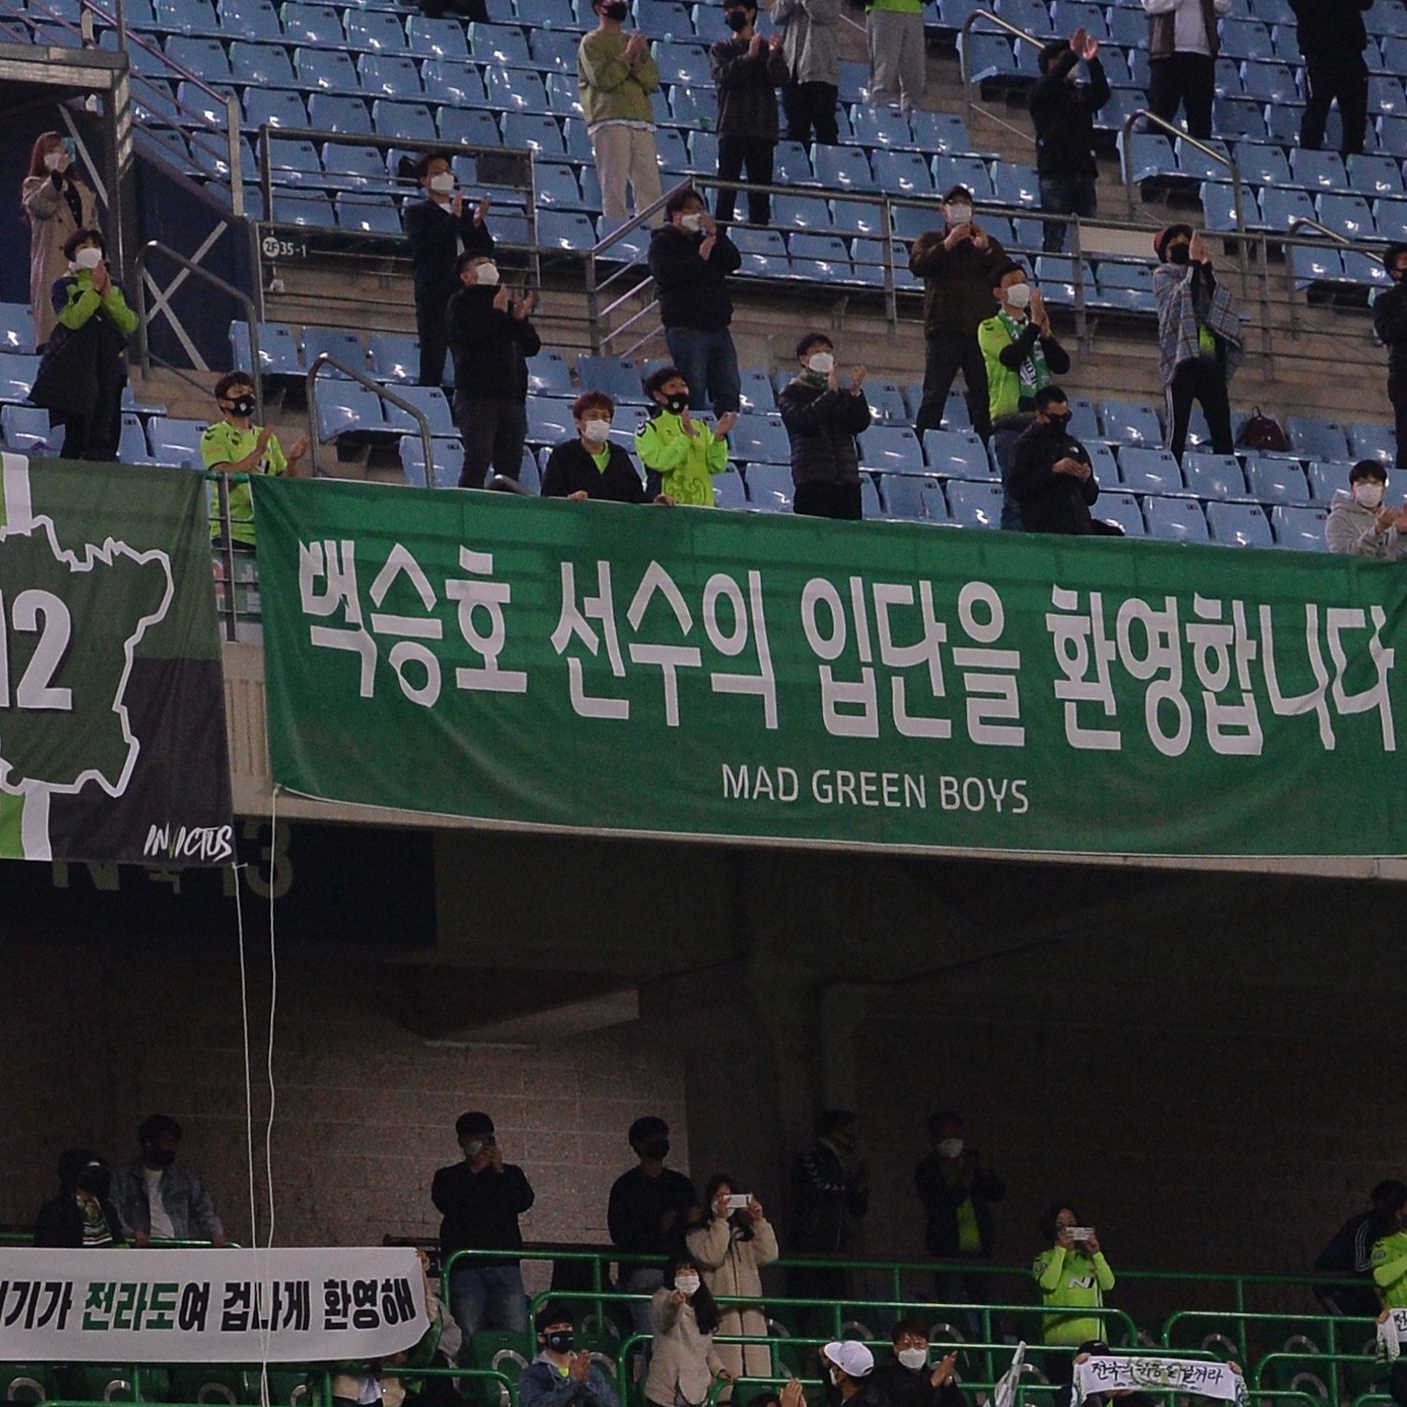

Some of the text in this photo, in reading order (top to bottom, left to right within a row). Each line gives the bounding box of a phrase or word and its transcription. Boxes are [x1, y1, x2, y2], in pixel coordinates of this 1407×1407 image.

[280, 241, 307, 257] 35-1
[298, 539, 1395, 756] 백승호 선수의 입단을 환영합니다
[721, 763, 1029, 815] MAD GREEN BOYS
[144, 823, 235, 859] INVICTUS
[82, 1281, 211, 1333] 전라도여
[220, 1280, 311, 1333] 겁나게
[323, 1277, 417, 1332] 환영해
